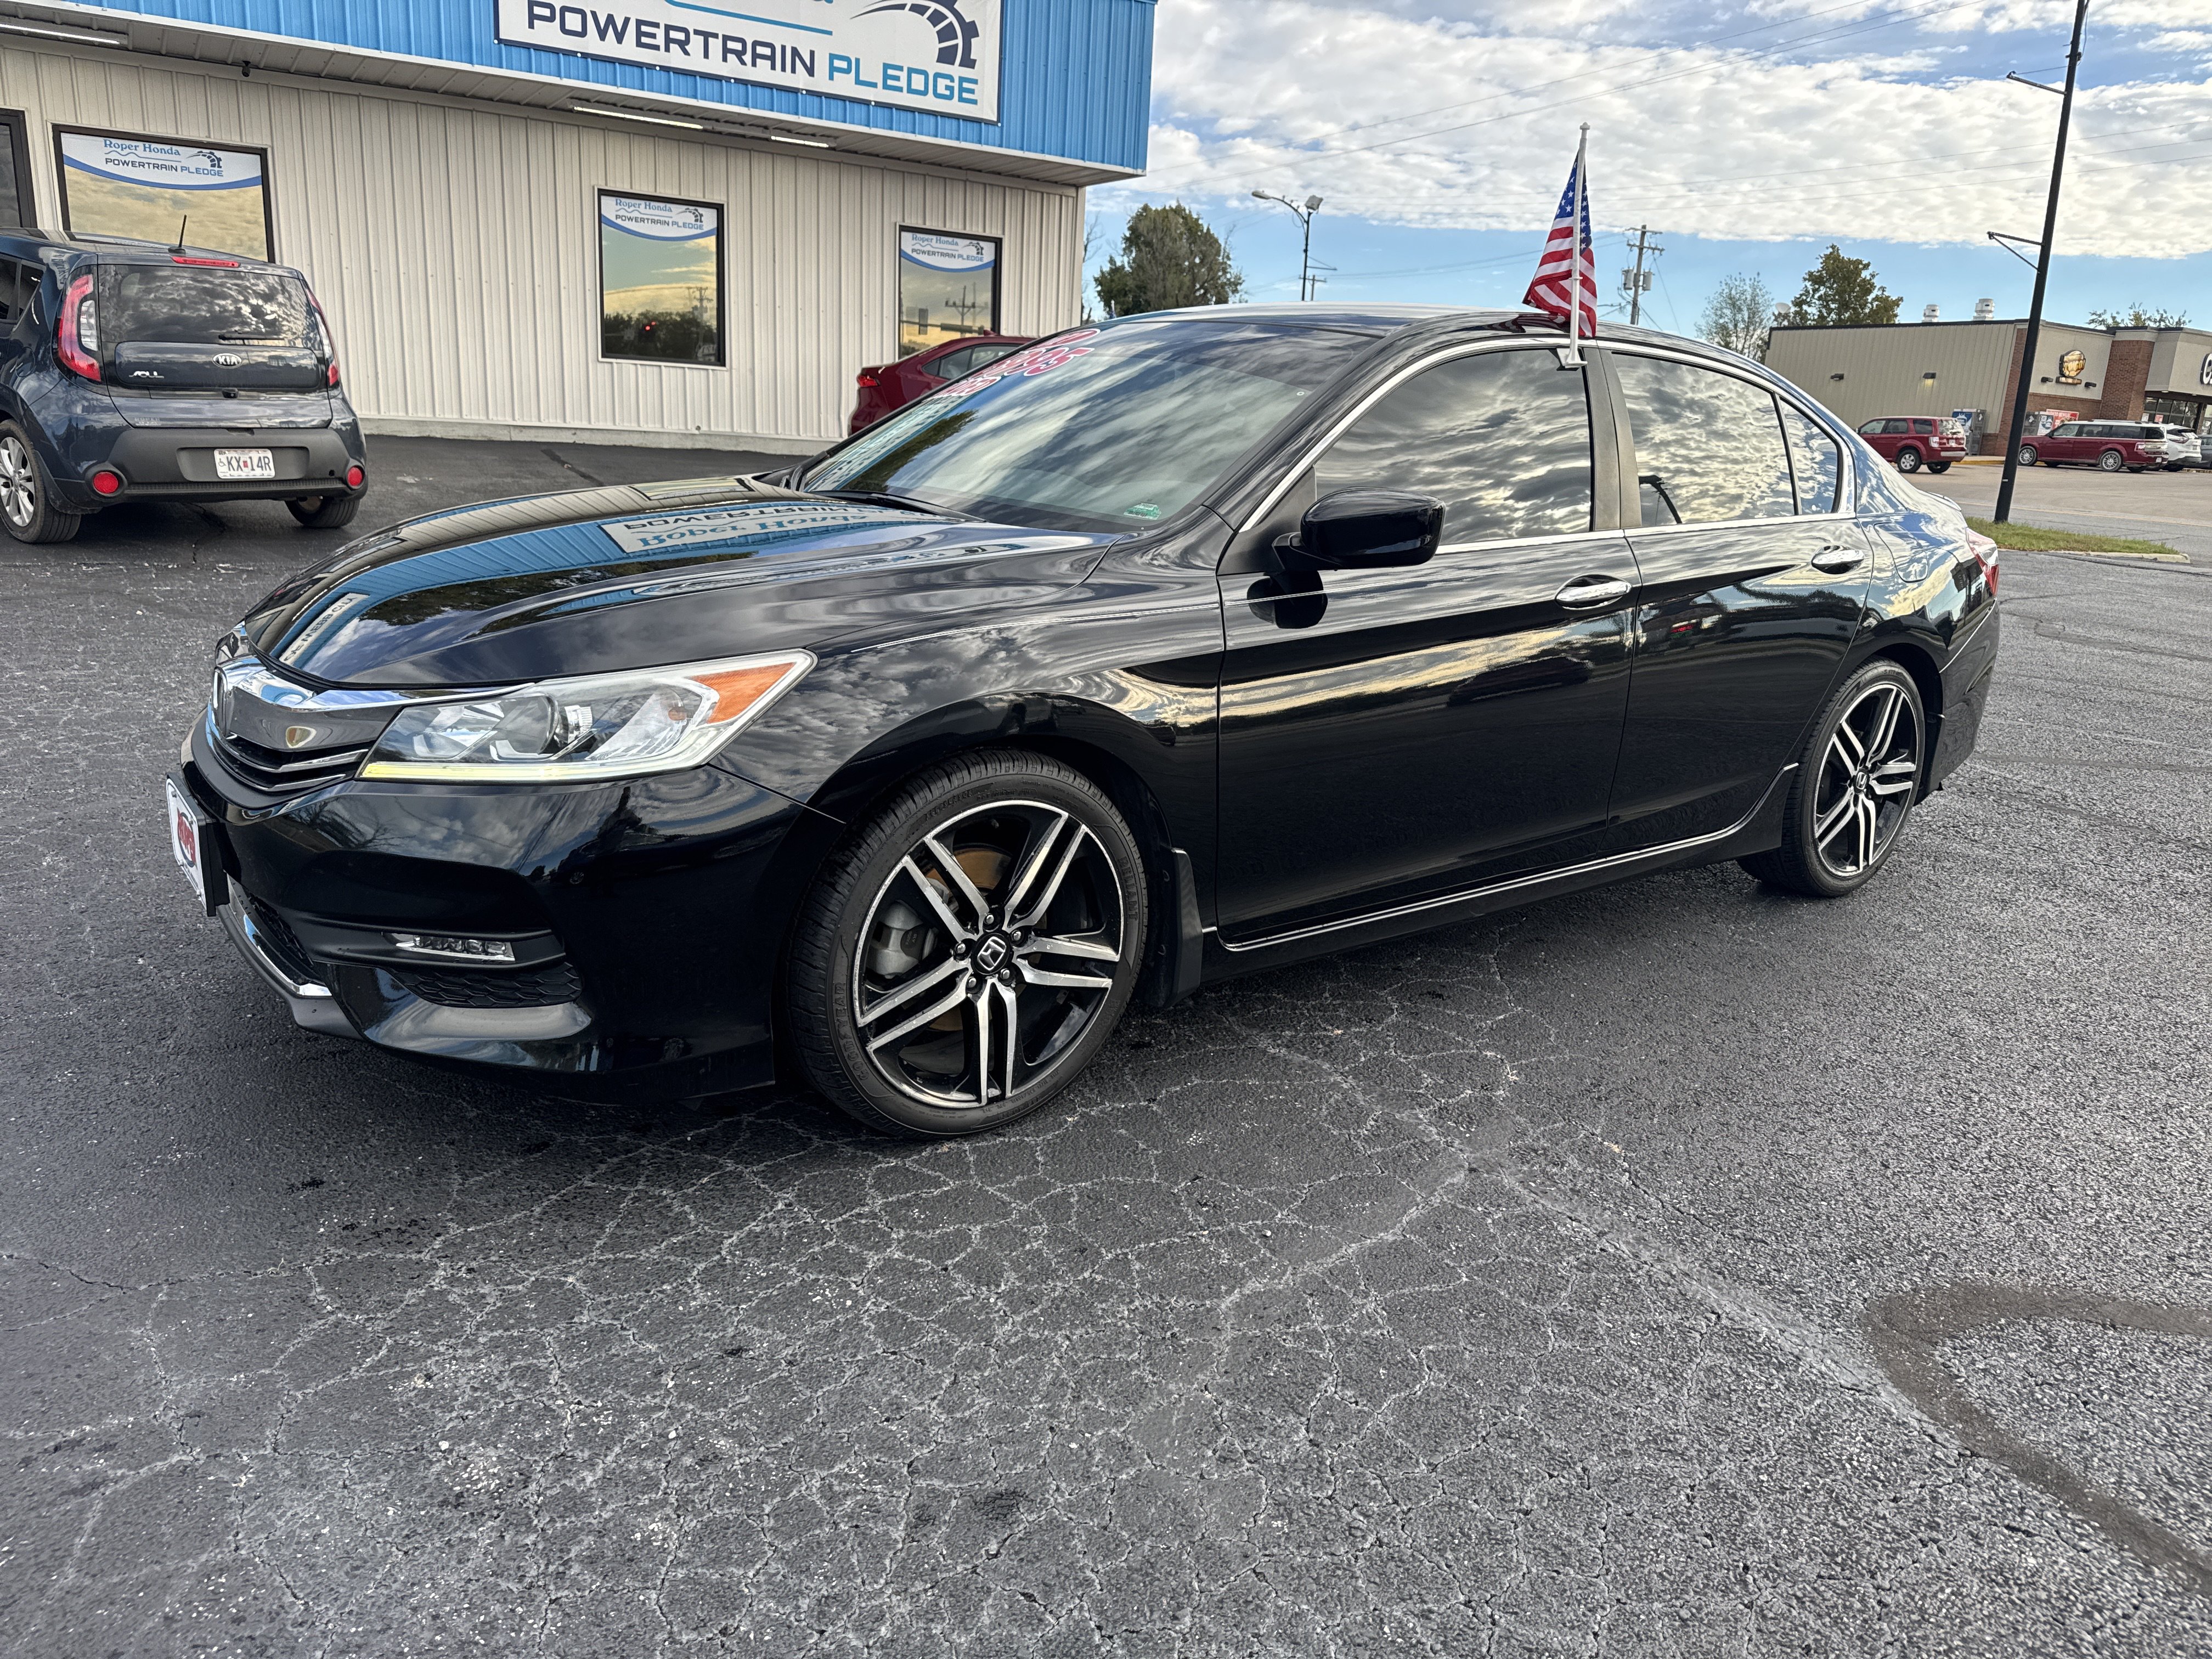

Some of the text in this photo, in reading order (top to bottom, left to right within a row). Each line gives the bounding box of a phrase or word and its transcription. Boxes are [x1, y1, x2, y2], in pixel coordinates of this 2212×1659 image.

[527, 0, 978, 104] POWERTRAIN PLEDGE
[103, 138, 181, 156] Roper Honda
[105, 157, 224, 177] POWERTRAIN PLEDGE
[615, 198, 673, 212] Roper Honda
[615, 215, 704, 230] POWERTRAIN PLEDGE
[911, 234, 958, 246] Roper Honda
[911, 249, 956, 259] POWERTRAIN
[218, 356, 239, 365] KIA
[249, 456, 272, 471] 14R
